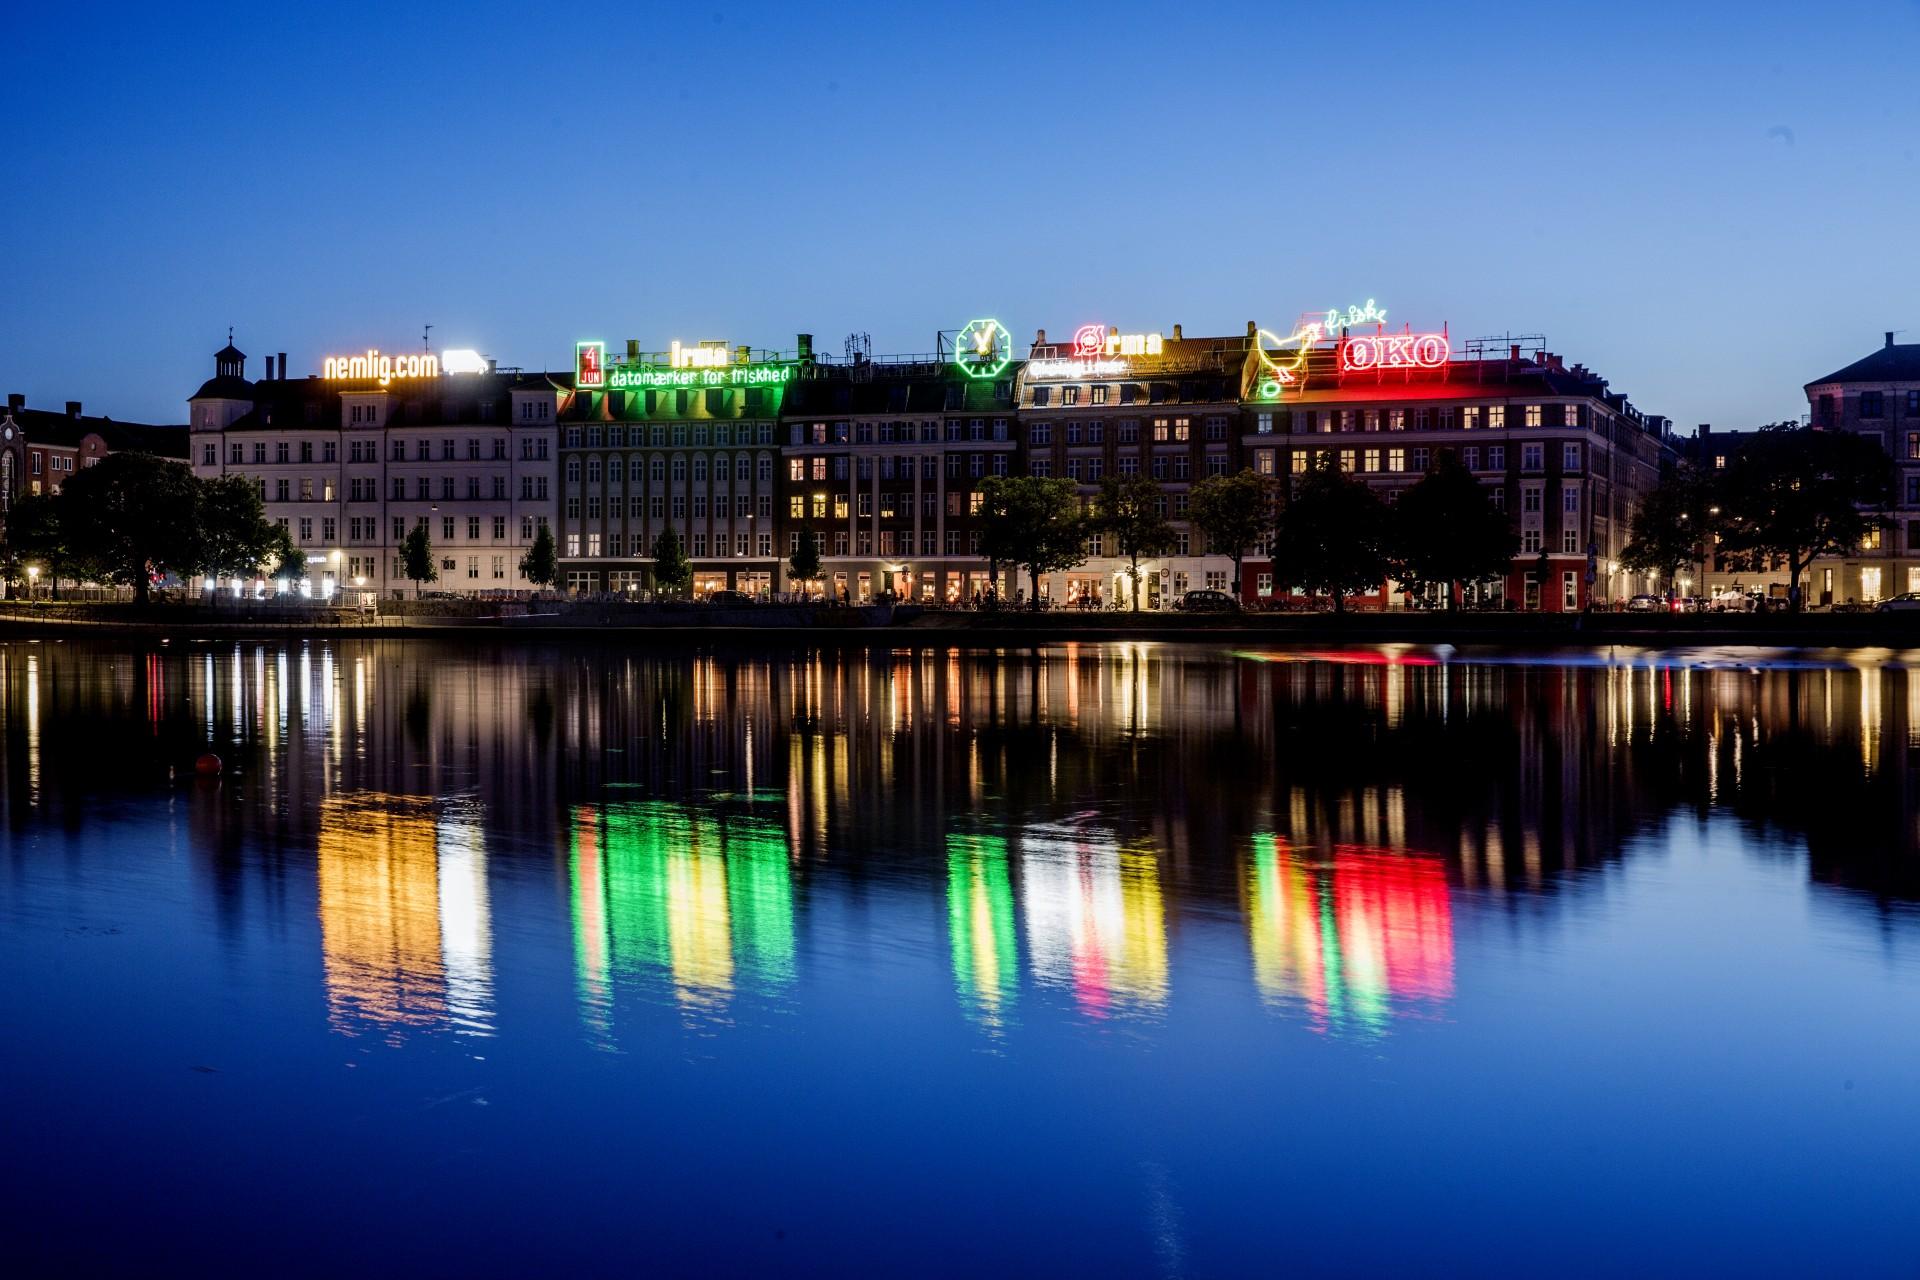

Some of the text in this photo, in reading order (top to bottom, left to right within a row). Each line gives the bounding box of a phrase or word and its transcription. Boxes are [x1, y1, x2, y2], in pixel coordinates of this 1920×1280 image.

[586, 347, 595, 369] 4
[671, 341, 727, 367] Irma
[1344, 335, 1449, 371] ØKO
[324, 349, 438, 385] nemlig.com
[581, 372, 600, 383] JUN
[611, 366, 790, 387] datomærker for friskhed
